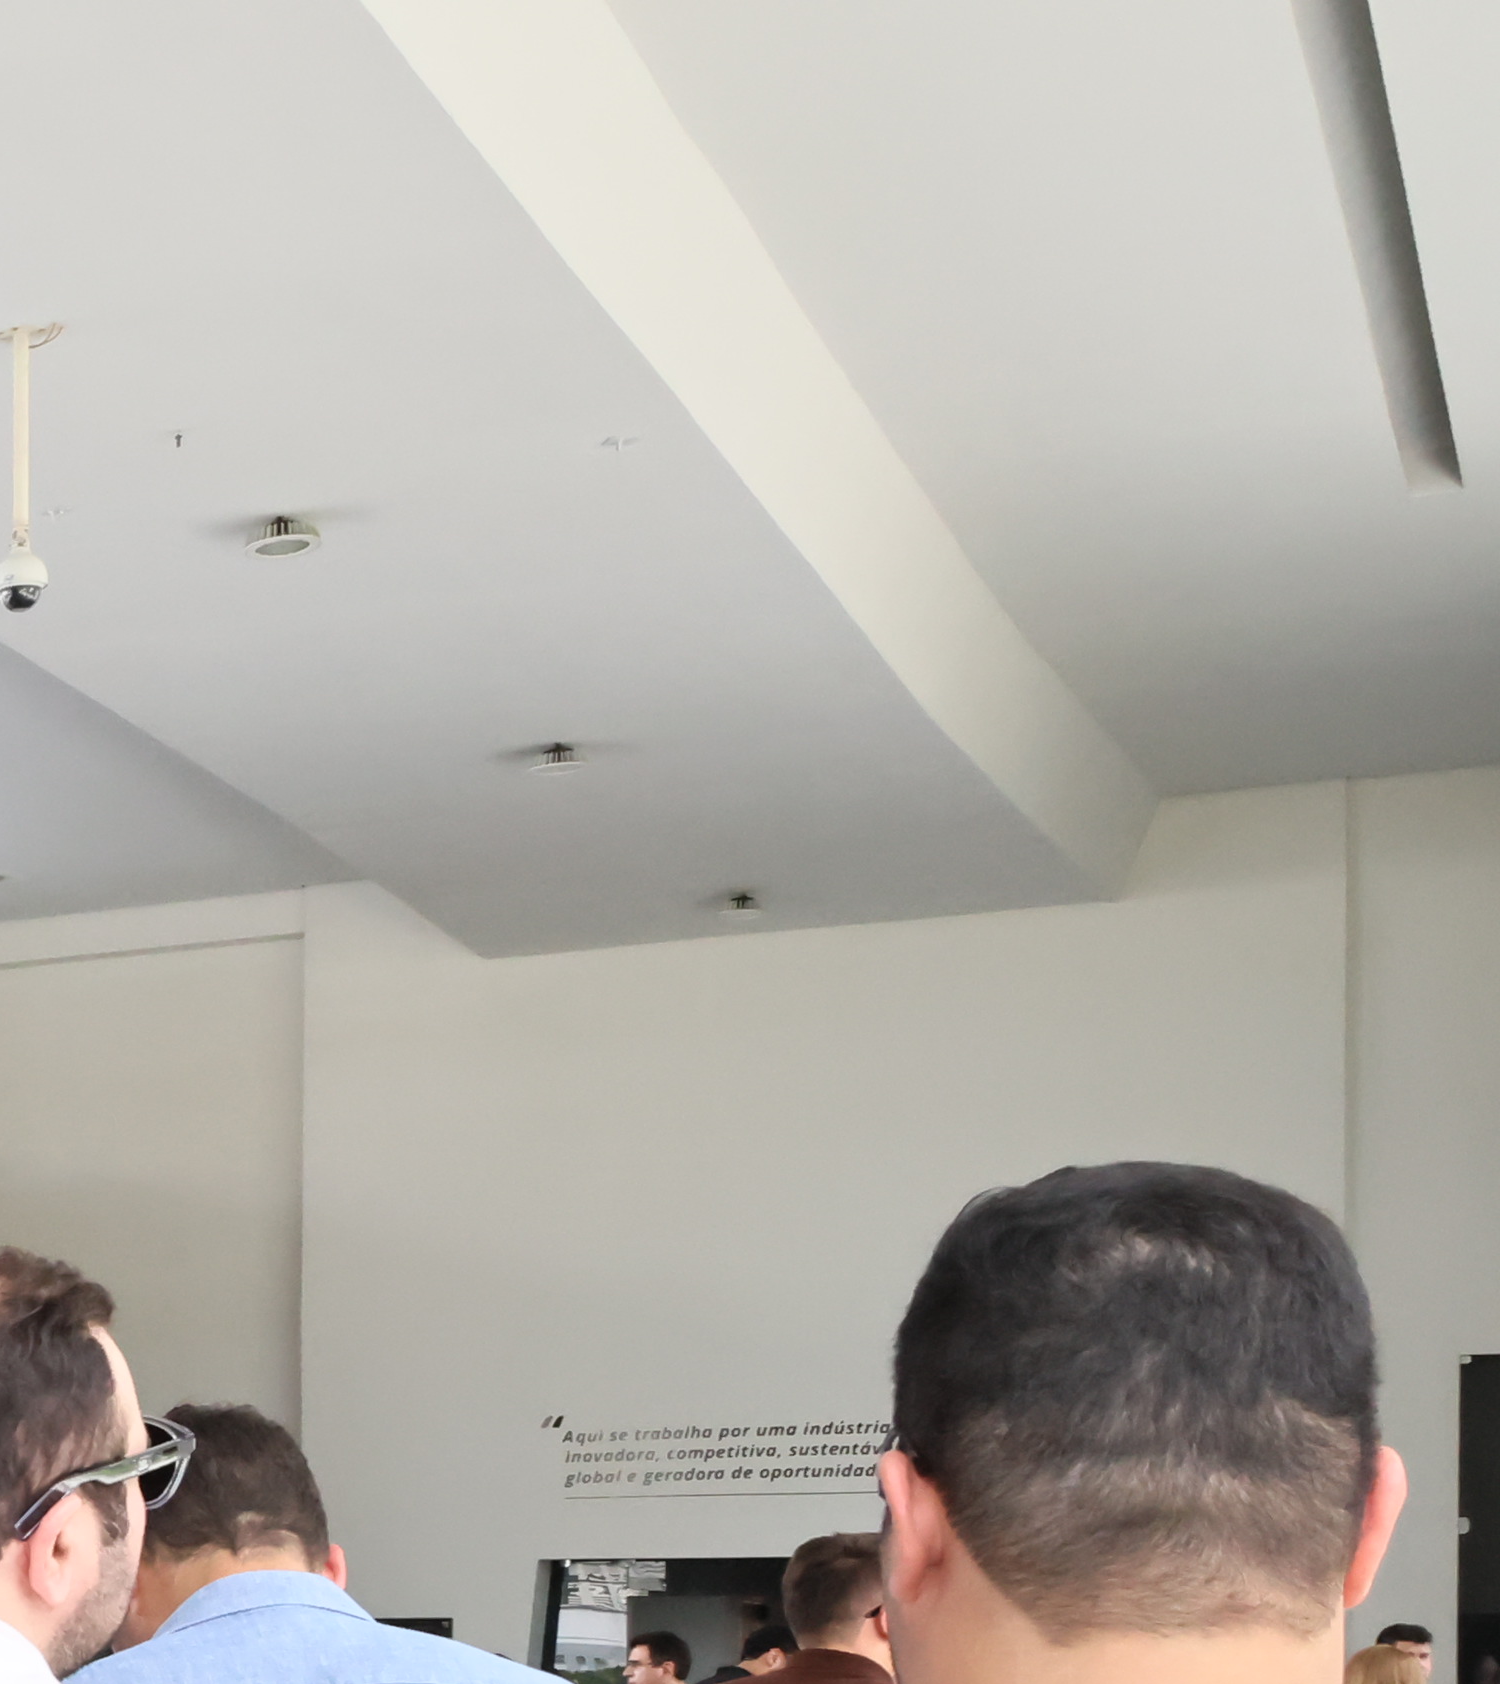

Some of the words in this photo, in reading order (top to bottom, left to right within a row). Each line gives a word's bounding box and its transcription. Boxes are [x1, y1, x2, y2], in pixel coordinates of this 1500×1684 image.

[562, 1430, 603, 1446] Aqui
[609, 1431, 629, 1442] se
[635, 1425, 713, 1441] trabalha
[718, 1425, 751, 1441] por
[756, 1425, 797, 1437] uma
[803, 1420, 891, 1436] indústria
[565, 1449, 660, 1464] inovadora,
[667, 1444, 781, 1463] competitiva,
[564, 1470, 622, 1488] global
[627, 1471, 637, 1482] e
[643, 1467, 725, 1486] geradora
[731, 1466, 753, 1480] de
